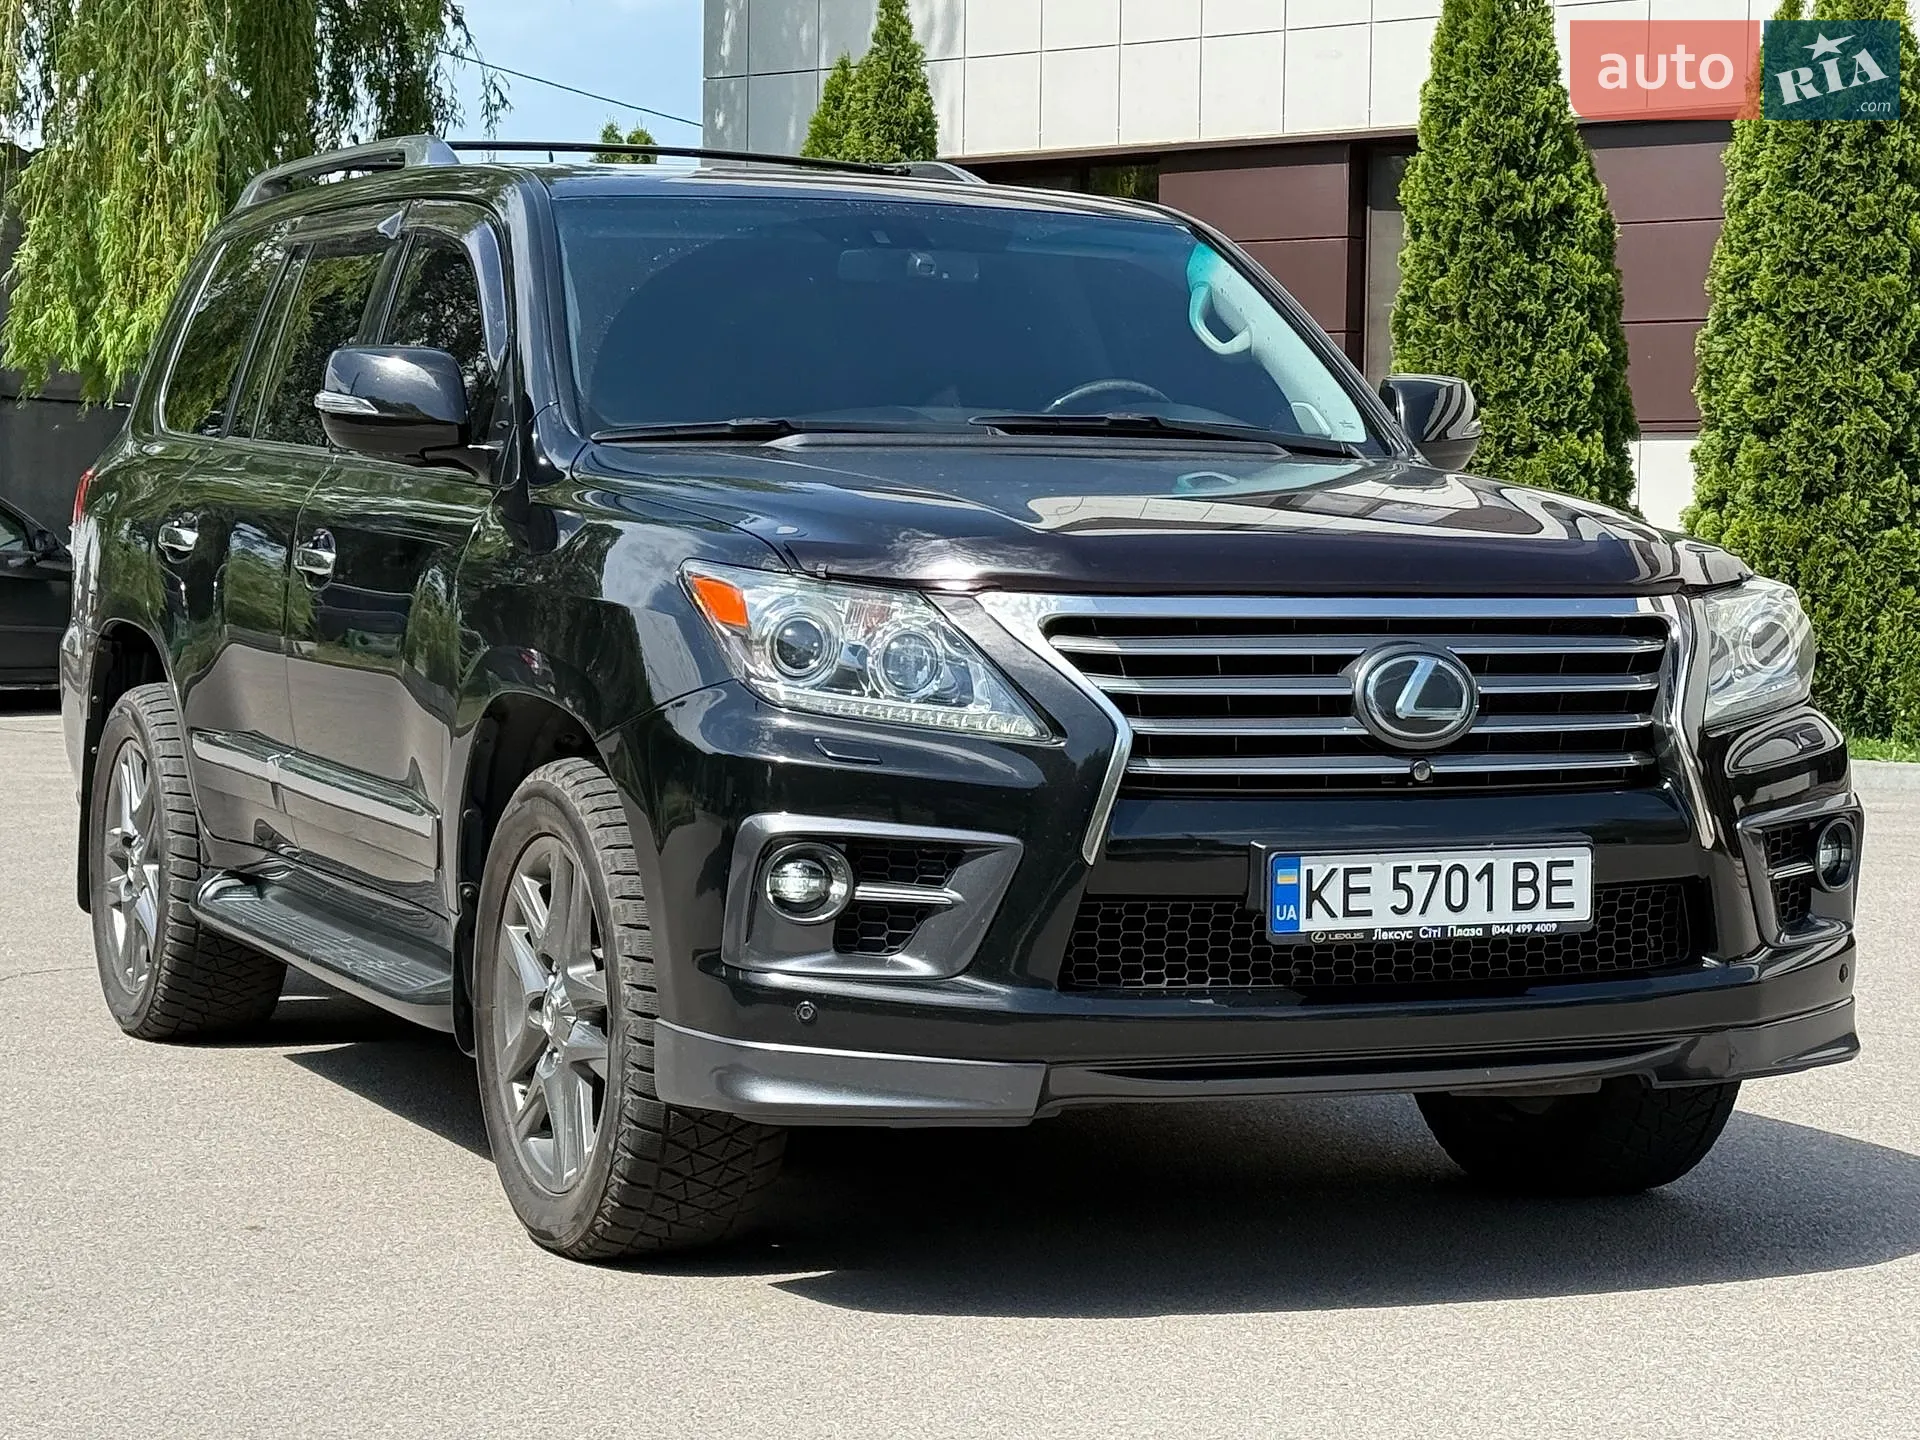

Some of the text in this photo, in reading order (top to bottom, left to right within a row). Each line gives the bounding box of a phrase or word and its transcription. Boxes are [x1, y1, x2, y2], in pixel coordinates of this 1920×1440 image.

[1306, 860, 1576, 920] KE 5701 BE
[1276, 905, 1297, 921] UA
[1328, 932, 1364, 941] LEXUS
[1372, 928, 1413, 941] Лексус
[1447, 925, 1483, 938] Плаза
[1491, 924, 1513, 936] (044)
[1515, 923, 1533, 934] 499
[1535, 923, 1557, 933] 4009
